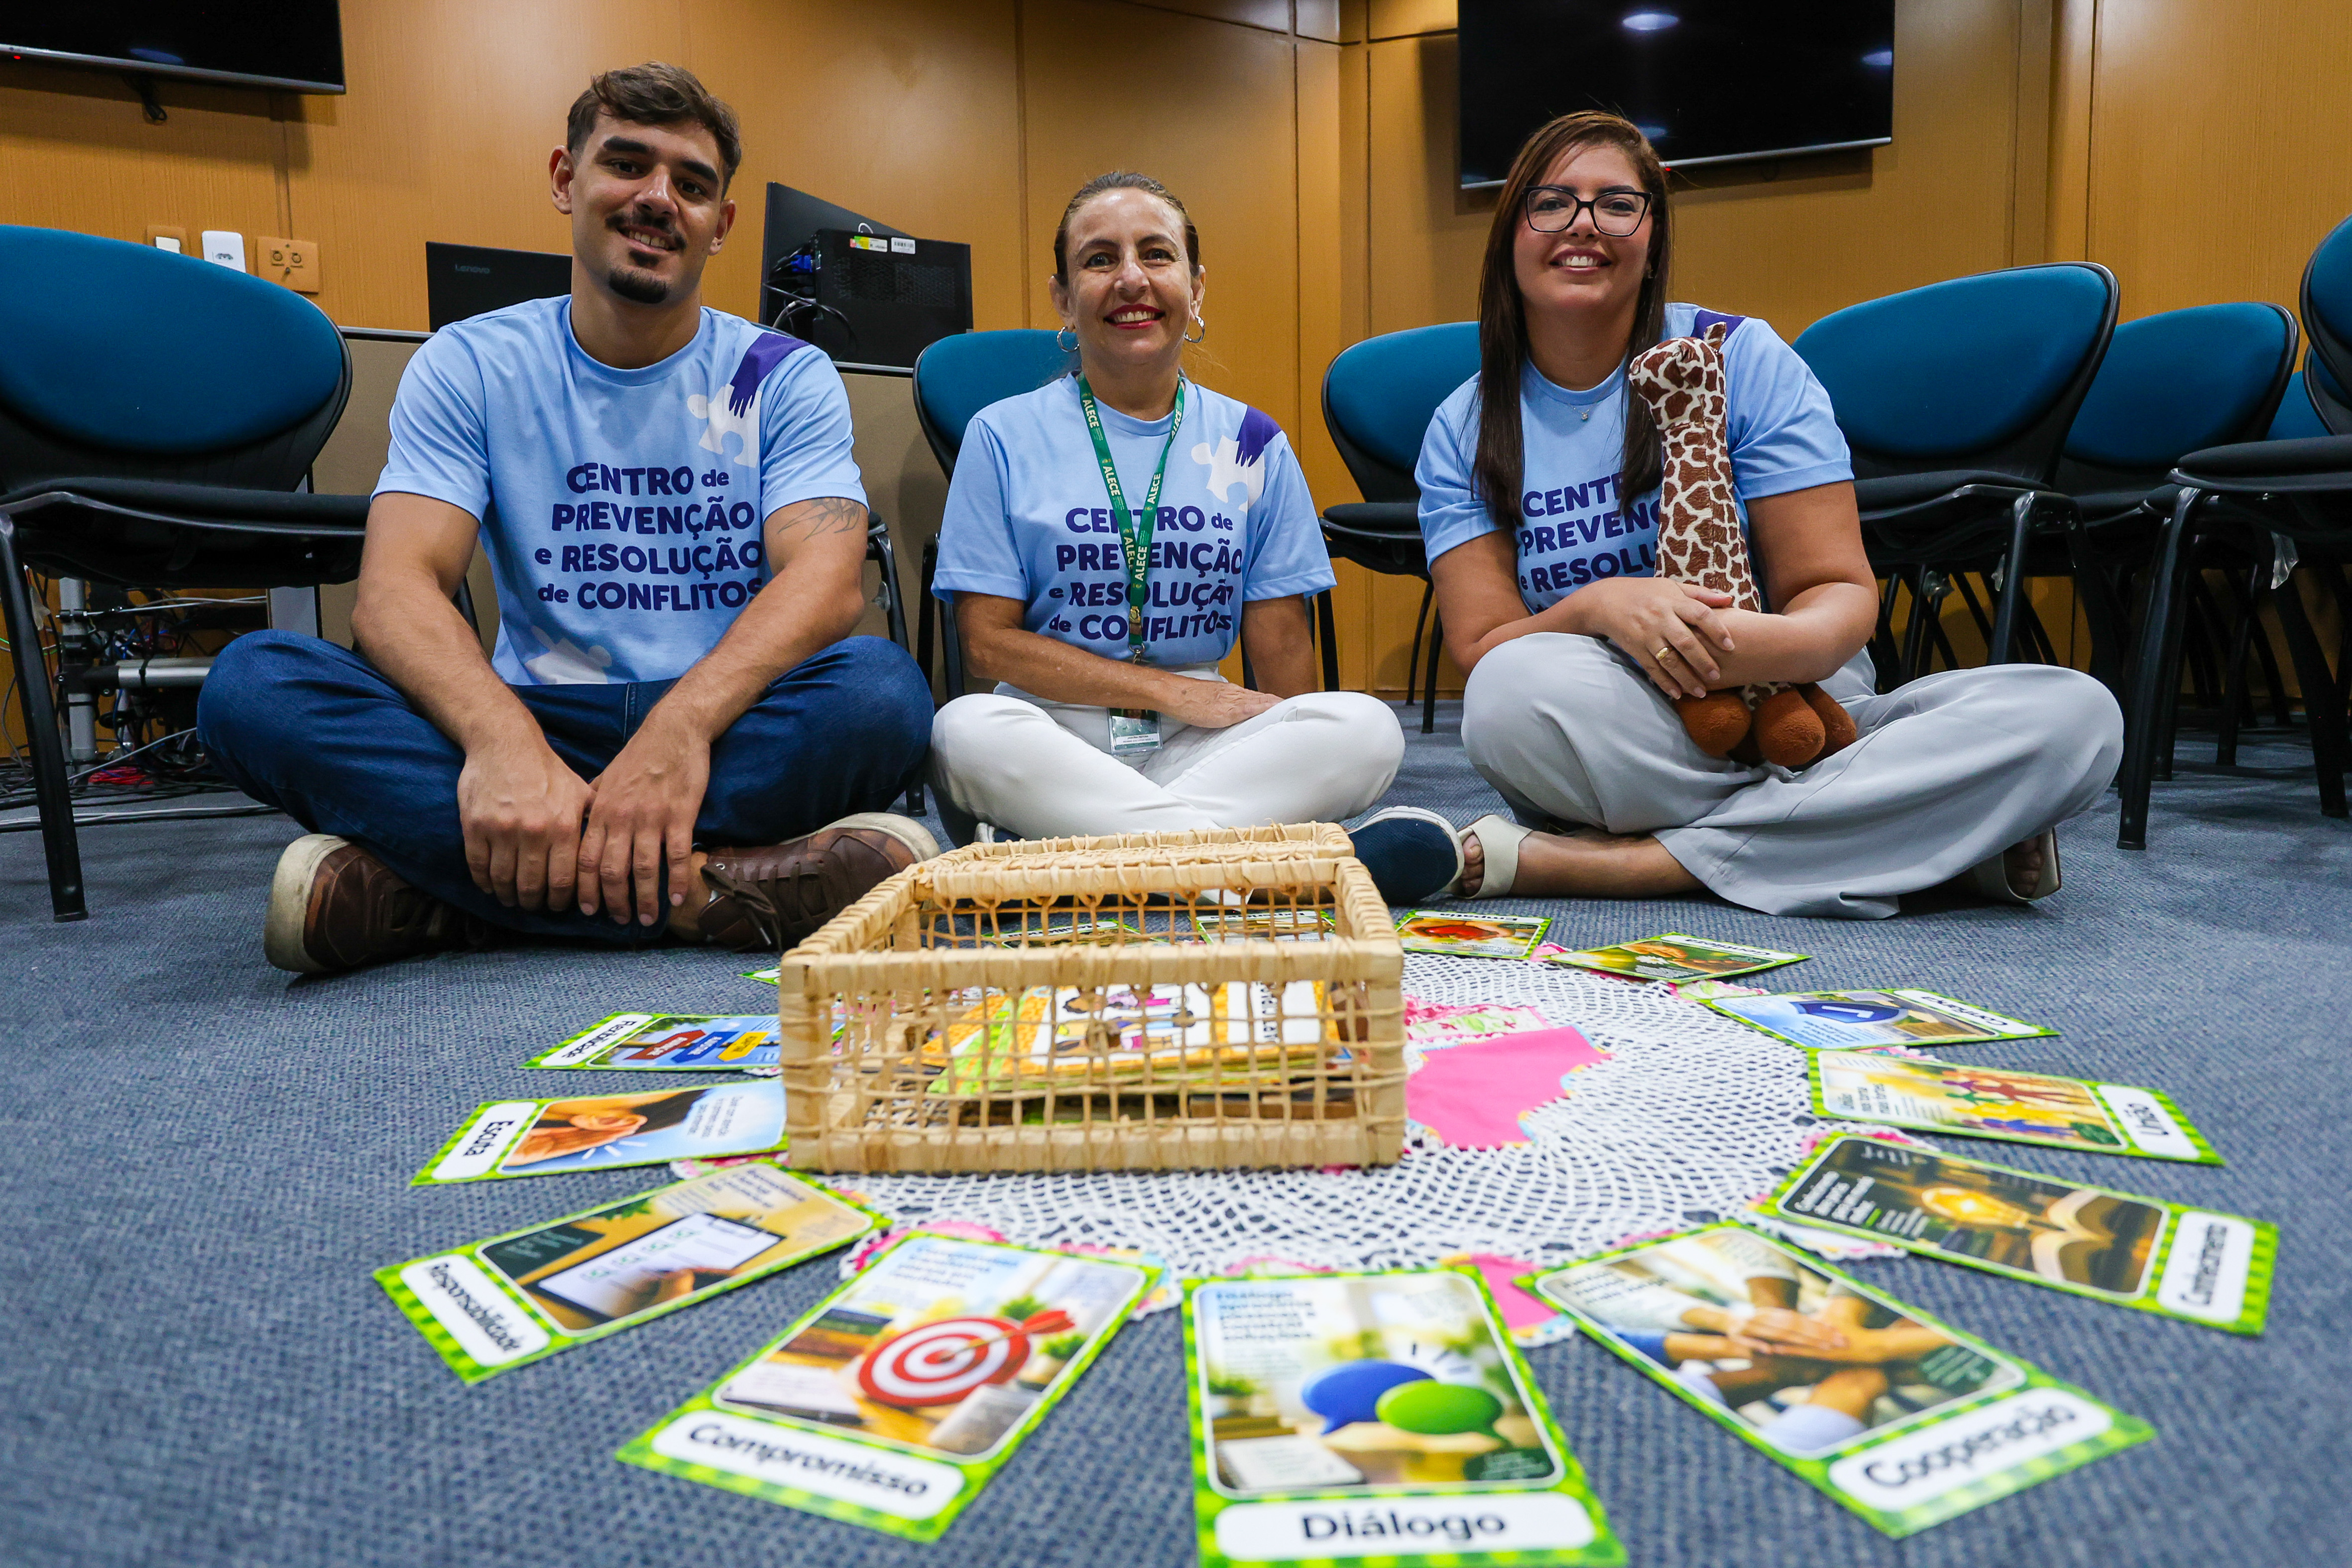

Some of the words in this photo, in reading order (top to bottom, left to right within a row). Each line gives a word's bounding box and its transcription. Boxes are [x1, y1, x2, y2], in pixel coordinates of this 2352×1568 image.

[1082, 399, 1100, 428] ALECE
[1171, 408, 1182, 439] ALECE
[566, 463, 694, 495] CENTRO
[701, 469, 729, 487] de
[1102, 466, 1121, 496] ALECE
[1147, 473, 1161, 504] ALECE
[551, 496, 755, 540] PREVENÇÃO
[1211, 513, 1233, 531] de
[534, 548, 552, 565] e
[561, 537, 763, 580] RESOLUÇÃO
[1056, 538, 1242, 578] PREENÇÃO
[1134, 546, 1148, 582] ALECE
[538, 583, 569, 603] de
[1048, 587, 1064, 598] e
[1520, 575, 1529, 590] e
[1048, 614, 1072, 632] de
[561, 1021, 638, 1058] Flexibilidade
[464, 1120, 515, 1156] Escuta
[429, 1262, 520, 1351] Responsabilidade
[689, 1422, 930, 1496] Compromisso
[1864, 1403, 2079, 1490] Cooperação
[1302, 1509, 1508, 1544] Diálogo
